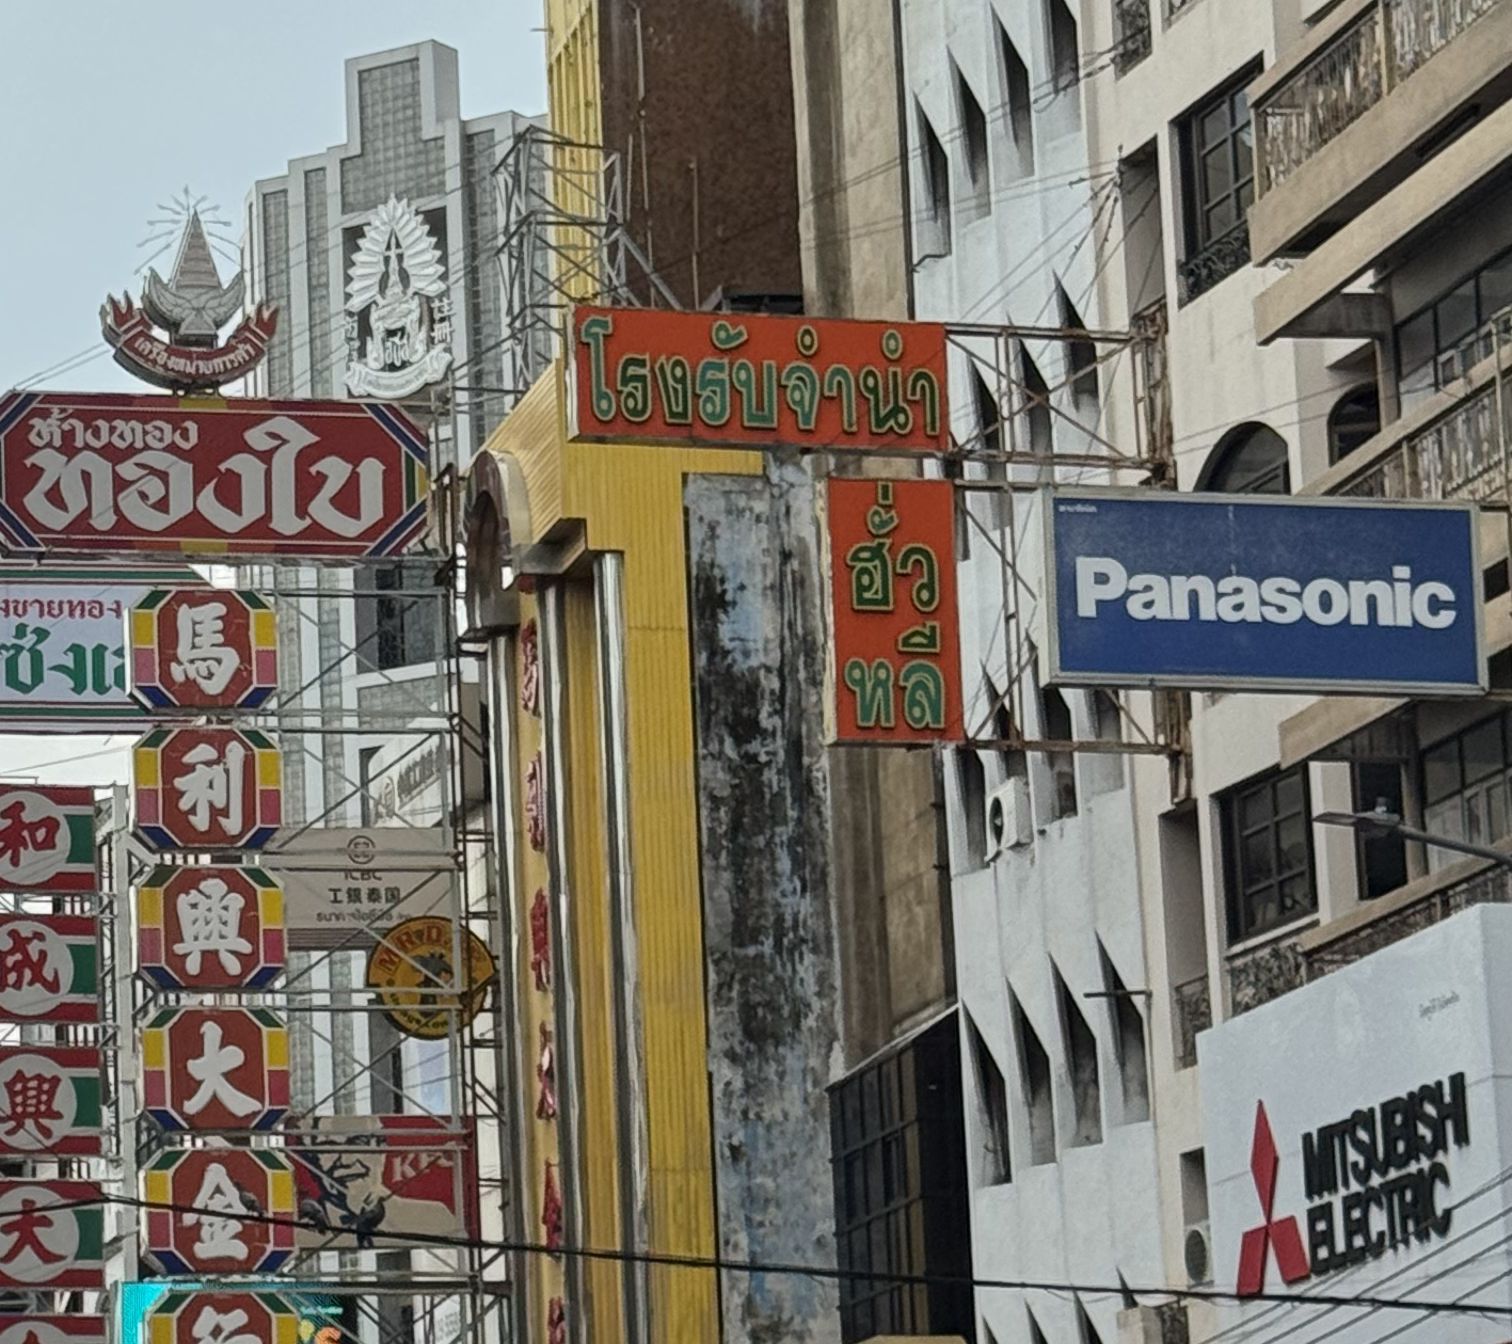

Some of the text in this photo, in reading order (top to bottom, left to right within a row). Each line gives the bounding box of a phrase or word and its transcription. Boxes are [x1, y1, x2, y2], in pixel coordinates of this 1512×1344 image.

[28, 407, 197, 450] ห้างทอง
[582, 317, 940, 436] โรงรับจำนำ
[23, 417, 386, 537] ทองใบ
[1075, 557, 1456, 629] Panasonic
[845, 623, 946, 728] หลี
[1307, 1162, 1452, 1276] ELECTRIC
